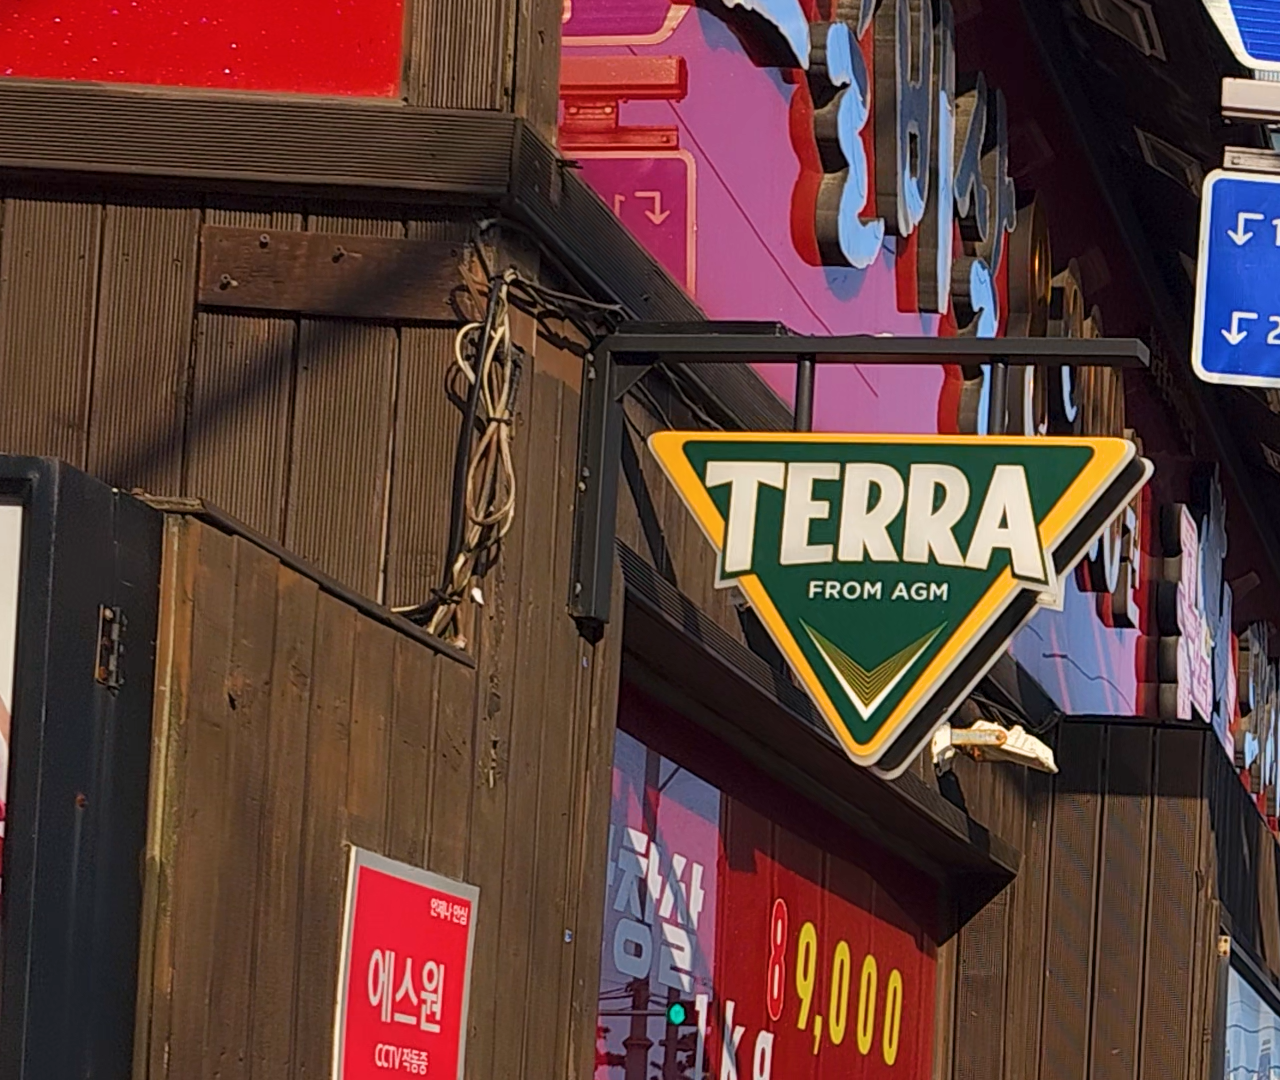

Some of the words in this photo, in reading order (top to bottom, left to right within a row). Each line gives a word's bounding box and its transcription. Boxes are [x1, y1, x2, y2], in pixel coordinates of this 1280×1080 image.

[705, 460, 1047, 582] TERRA
[808, 580, 881, 600] FROM
[890, 582, 949, 602] AGM
[367, 948, 446, 1034] 에스원
[766, 898, 904, 1067] 89,000
[374, 1042, 402, 1070] CCTV
[402, 1047, 429, 1076] 작동중
